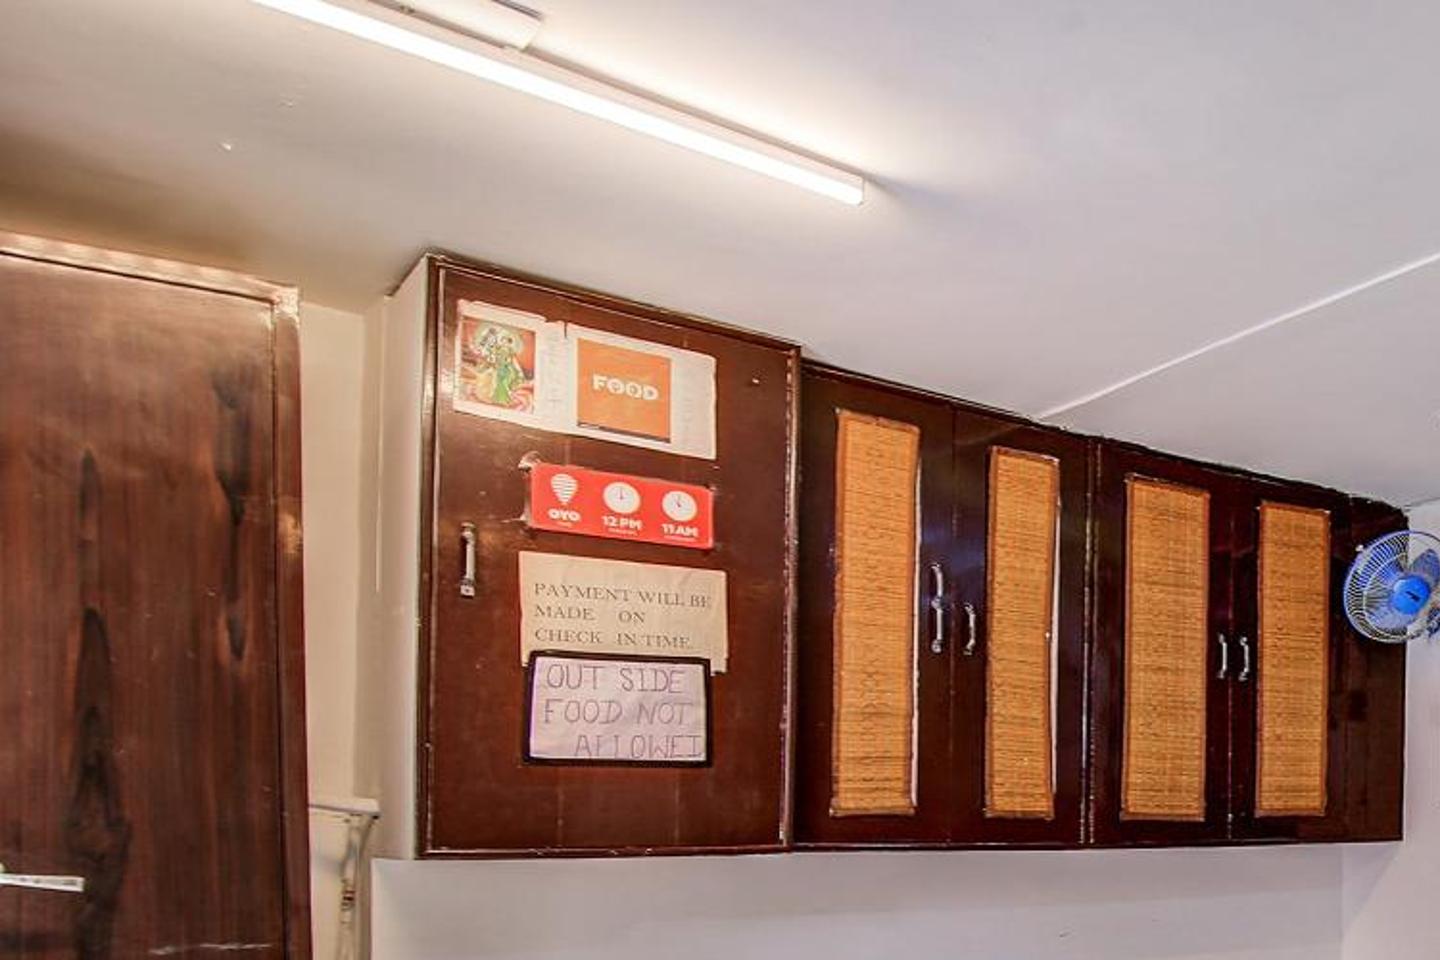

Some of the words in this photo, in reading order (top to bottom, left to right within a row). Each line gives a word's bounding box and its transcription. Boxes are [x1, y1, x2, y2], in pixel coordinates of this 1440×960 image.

[592, 373, 659, 401] FOOD
[548, 508, 581, 522] OYO
[602, 515, 617, 527] 12
[619, 517, 643, 530] PM
[534, 583, 633, 602] PAYMENT
[637, 591, 684, 606] WILL
[690, 594, 712, 608] BE
[534, 604, 595, 621] MADE
[618, 610, 646, 624] ON
[534, 628, 603, 645] CHECK
[617, 632, 637, 646] IN
[546, 663, 605, 690] OUT
[619, 667, 686, 694] SIDE
[544, 698, 623, 725] FOOD
[635, 701, 694, 725] NOT
